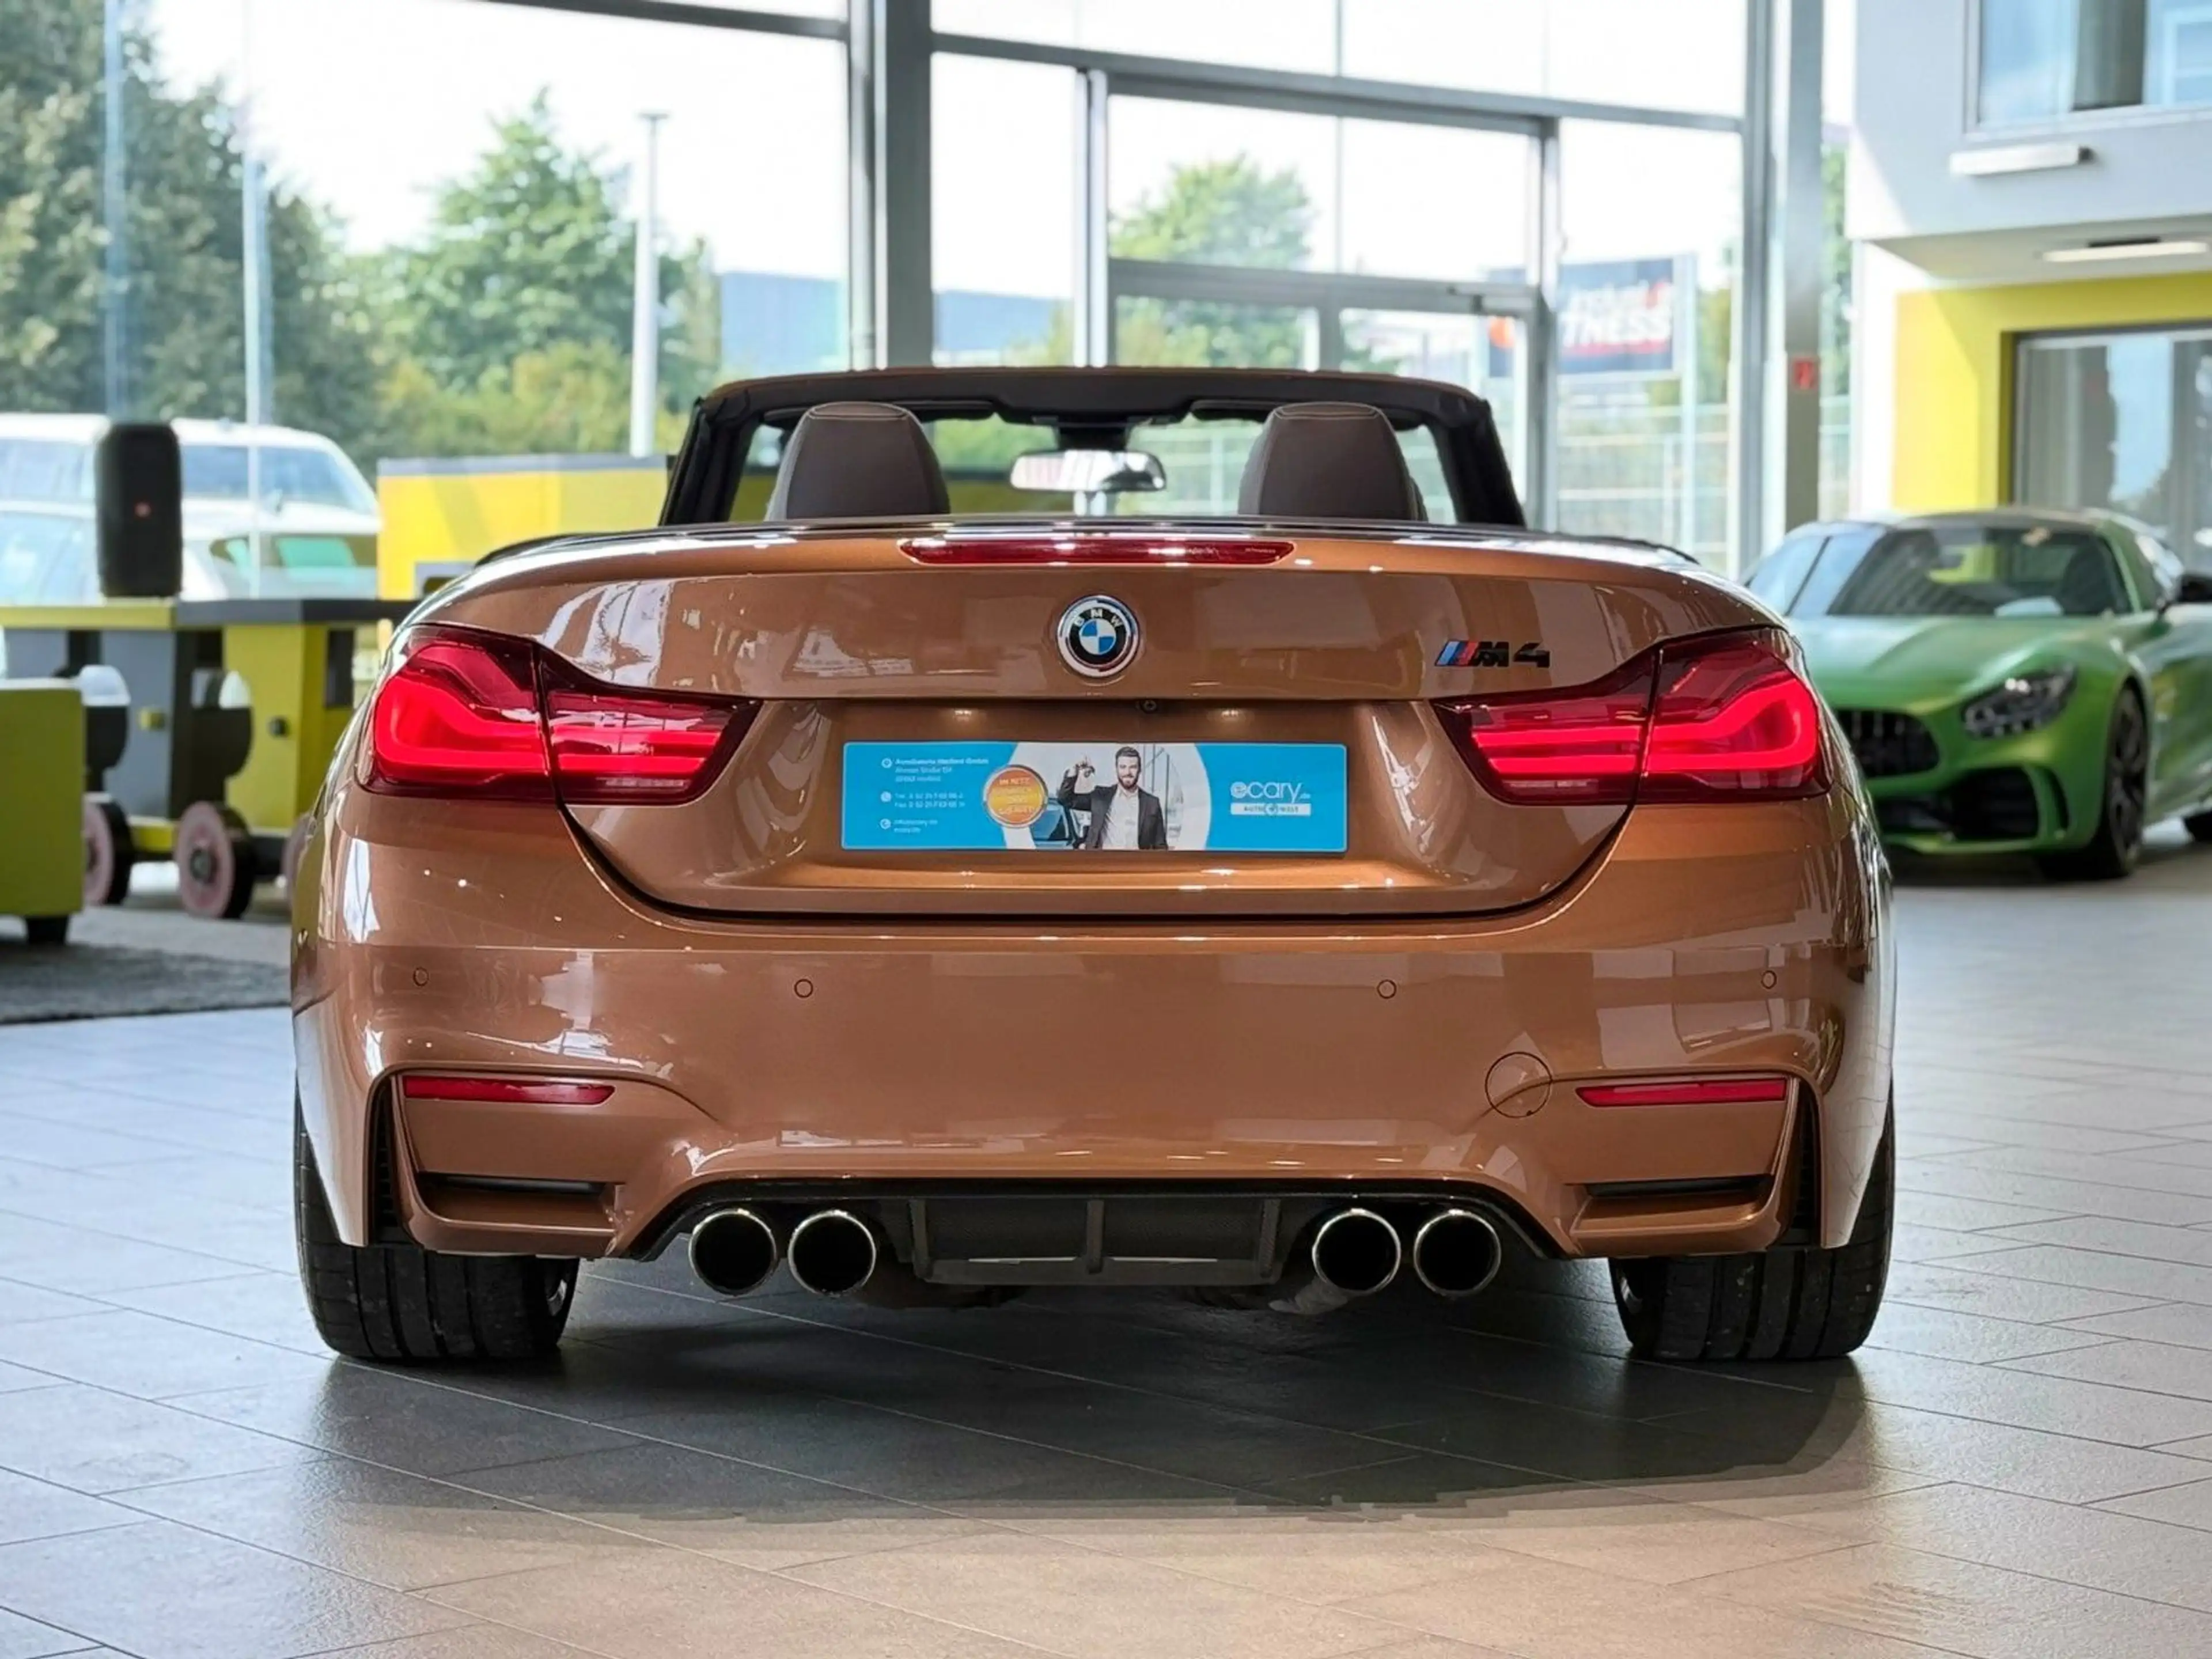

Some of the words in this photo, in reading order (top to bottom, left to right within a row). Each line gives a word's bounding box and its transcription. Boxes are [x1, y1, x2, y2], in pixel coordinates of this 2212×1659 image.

[1560, 307, 1671, 347] TNESS
[1074, 608, 1123, 627] BMW
[1471, 641, 1551, 668] M4
